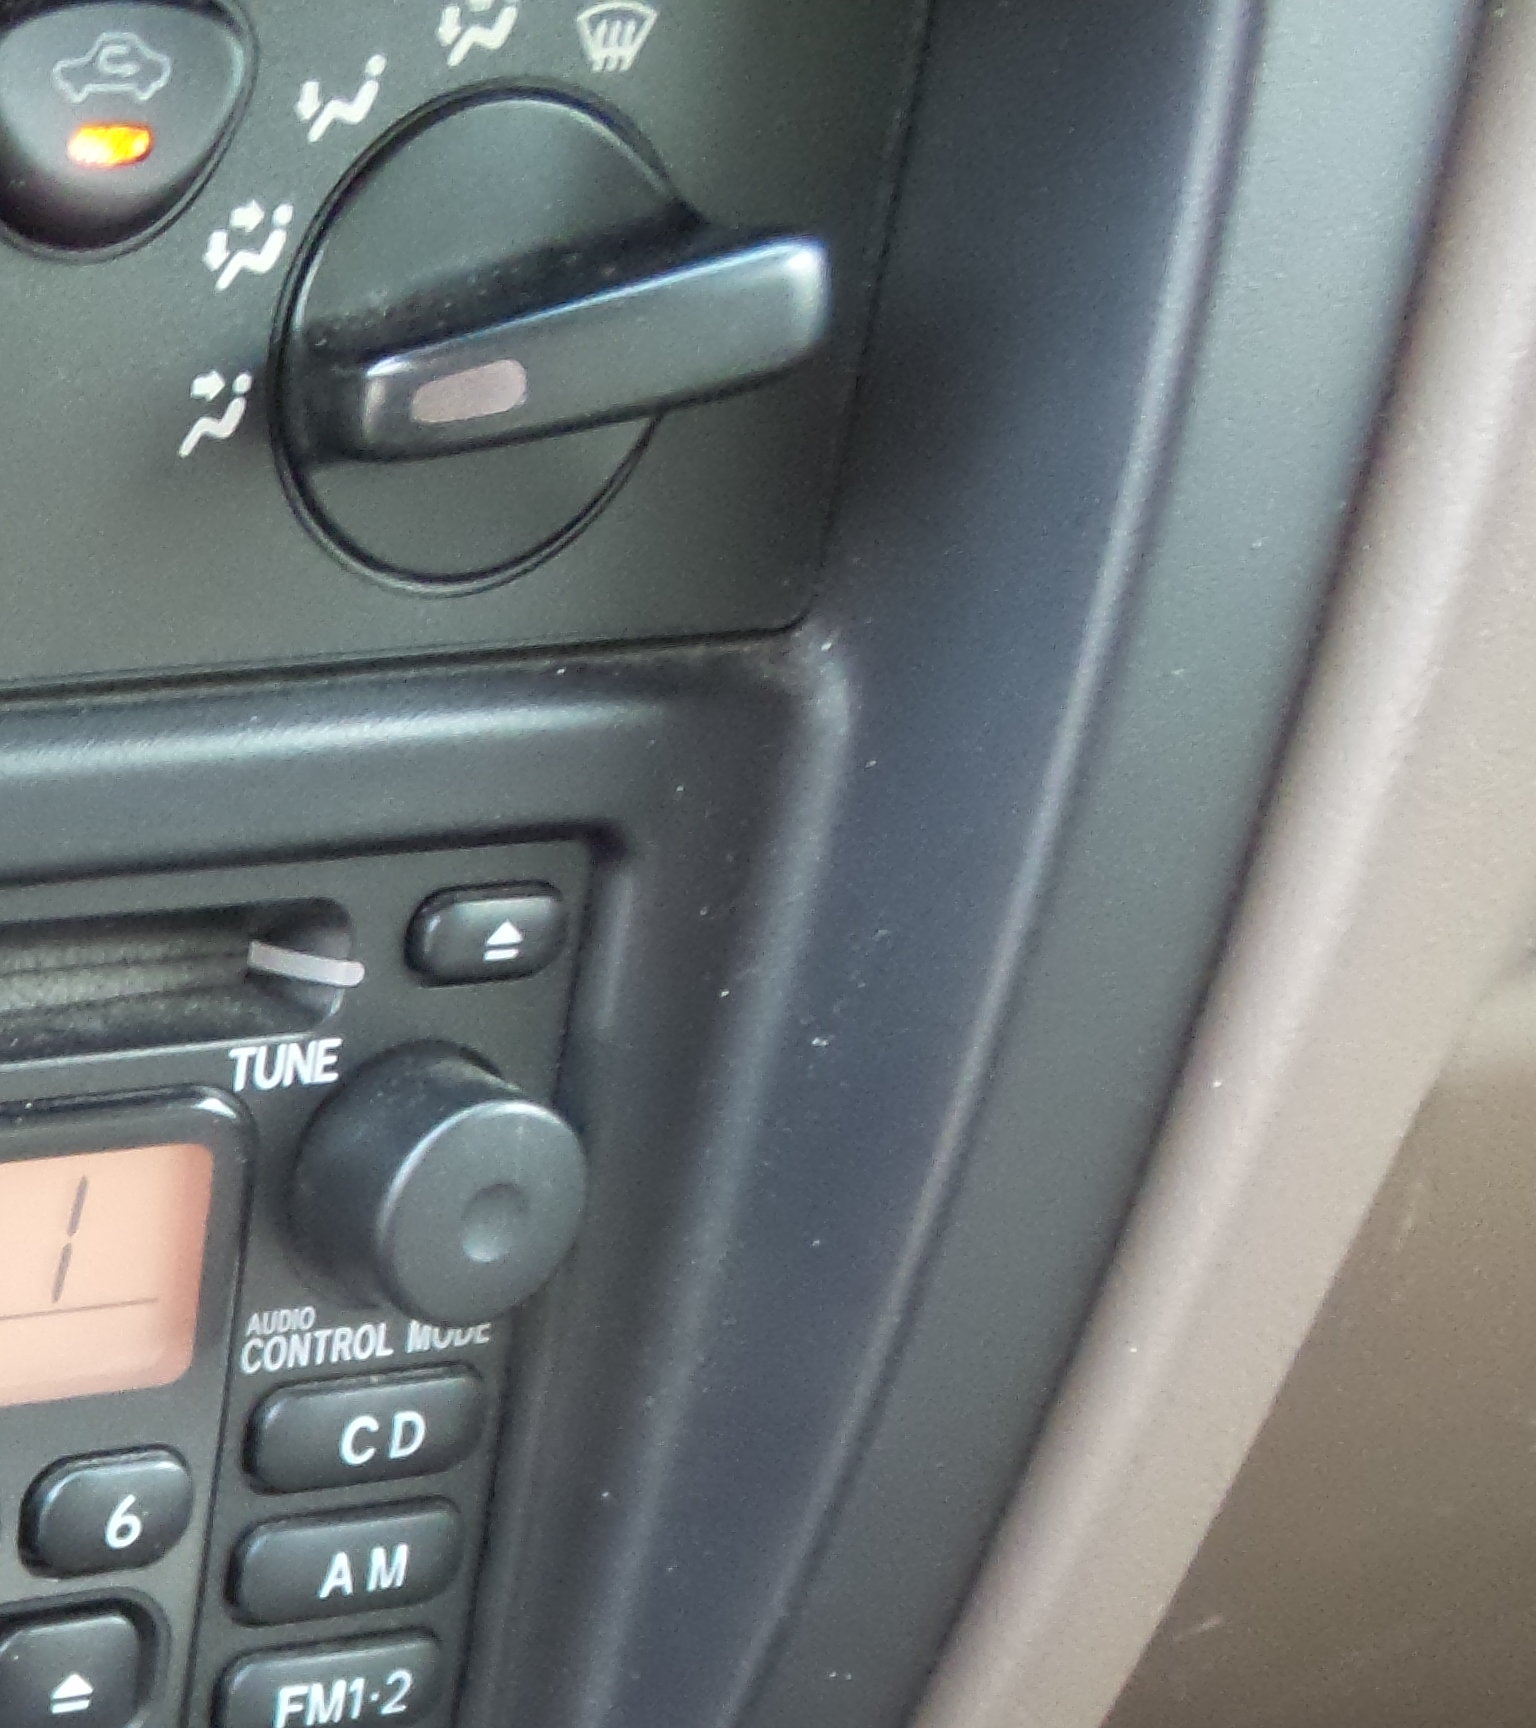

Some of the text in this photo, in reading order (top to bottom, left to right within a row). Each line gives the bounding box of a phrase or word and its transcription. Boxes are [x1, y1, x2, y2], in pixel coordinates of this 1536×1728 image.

[229, 1037, 343, 1092] TUNE
[241, 1322, 394, 1374] CONTROL
[247, 1306, 316, 1336] AUDIO
[106, 1493, 143, 1549] 6
[318, 1542, 410, 1599] AM
